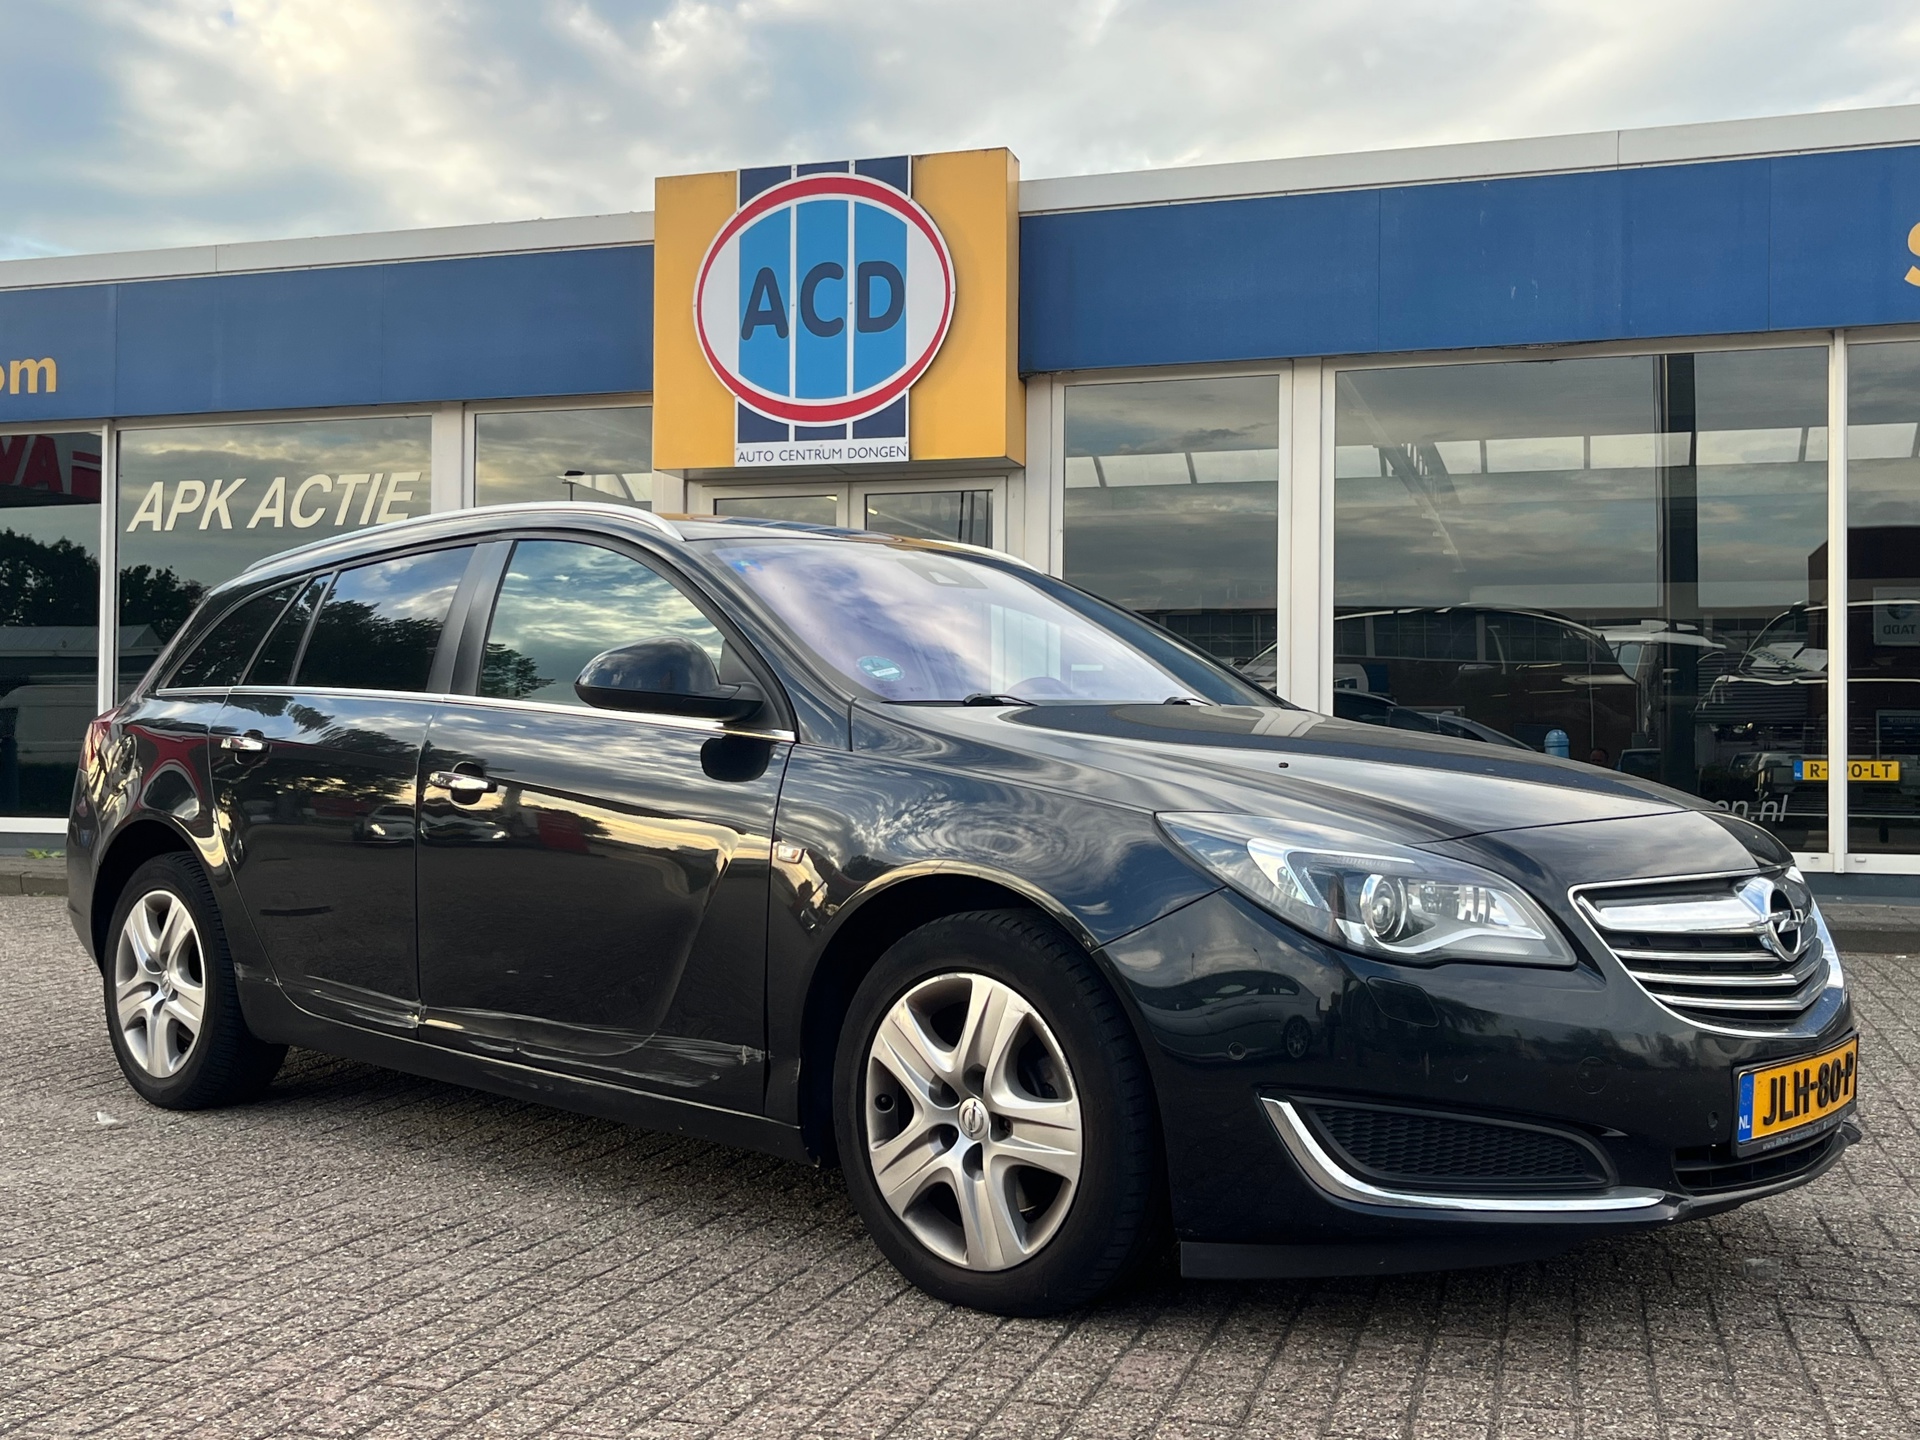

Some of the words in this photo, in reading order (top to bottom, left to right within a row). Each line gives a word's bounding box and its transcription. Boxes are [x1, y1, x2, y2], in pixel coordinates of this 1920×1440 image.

[741, 261, 905, 340] ACD
[0, 357, 57, 394] m
[737, 450, 775, 463] AUTO
[779, 448, 842, 461] CENTRUM
[848, 446, 906, 459] DONGEN
[126, 478, 247, 532] APK
[246, 472, 422, 529] ACTIE
[1810, 764, 1892, 778] R-0-LT
[1738, 1115, 1751, 1130] NL
[1763, 1051, 1854, 1126] JLH-80-P
